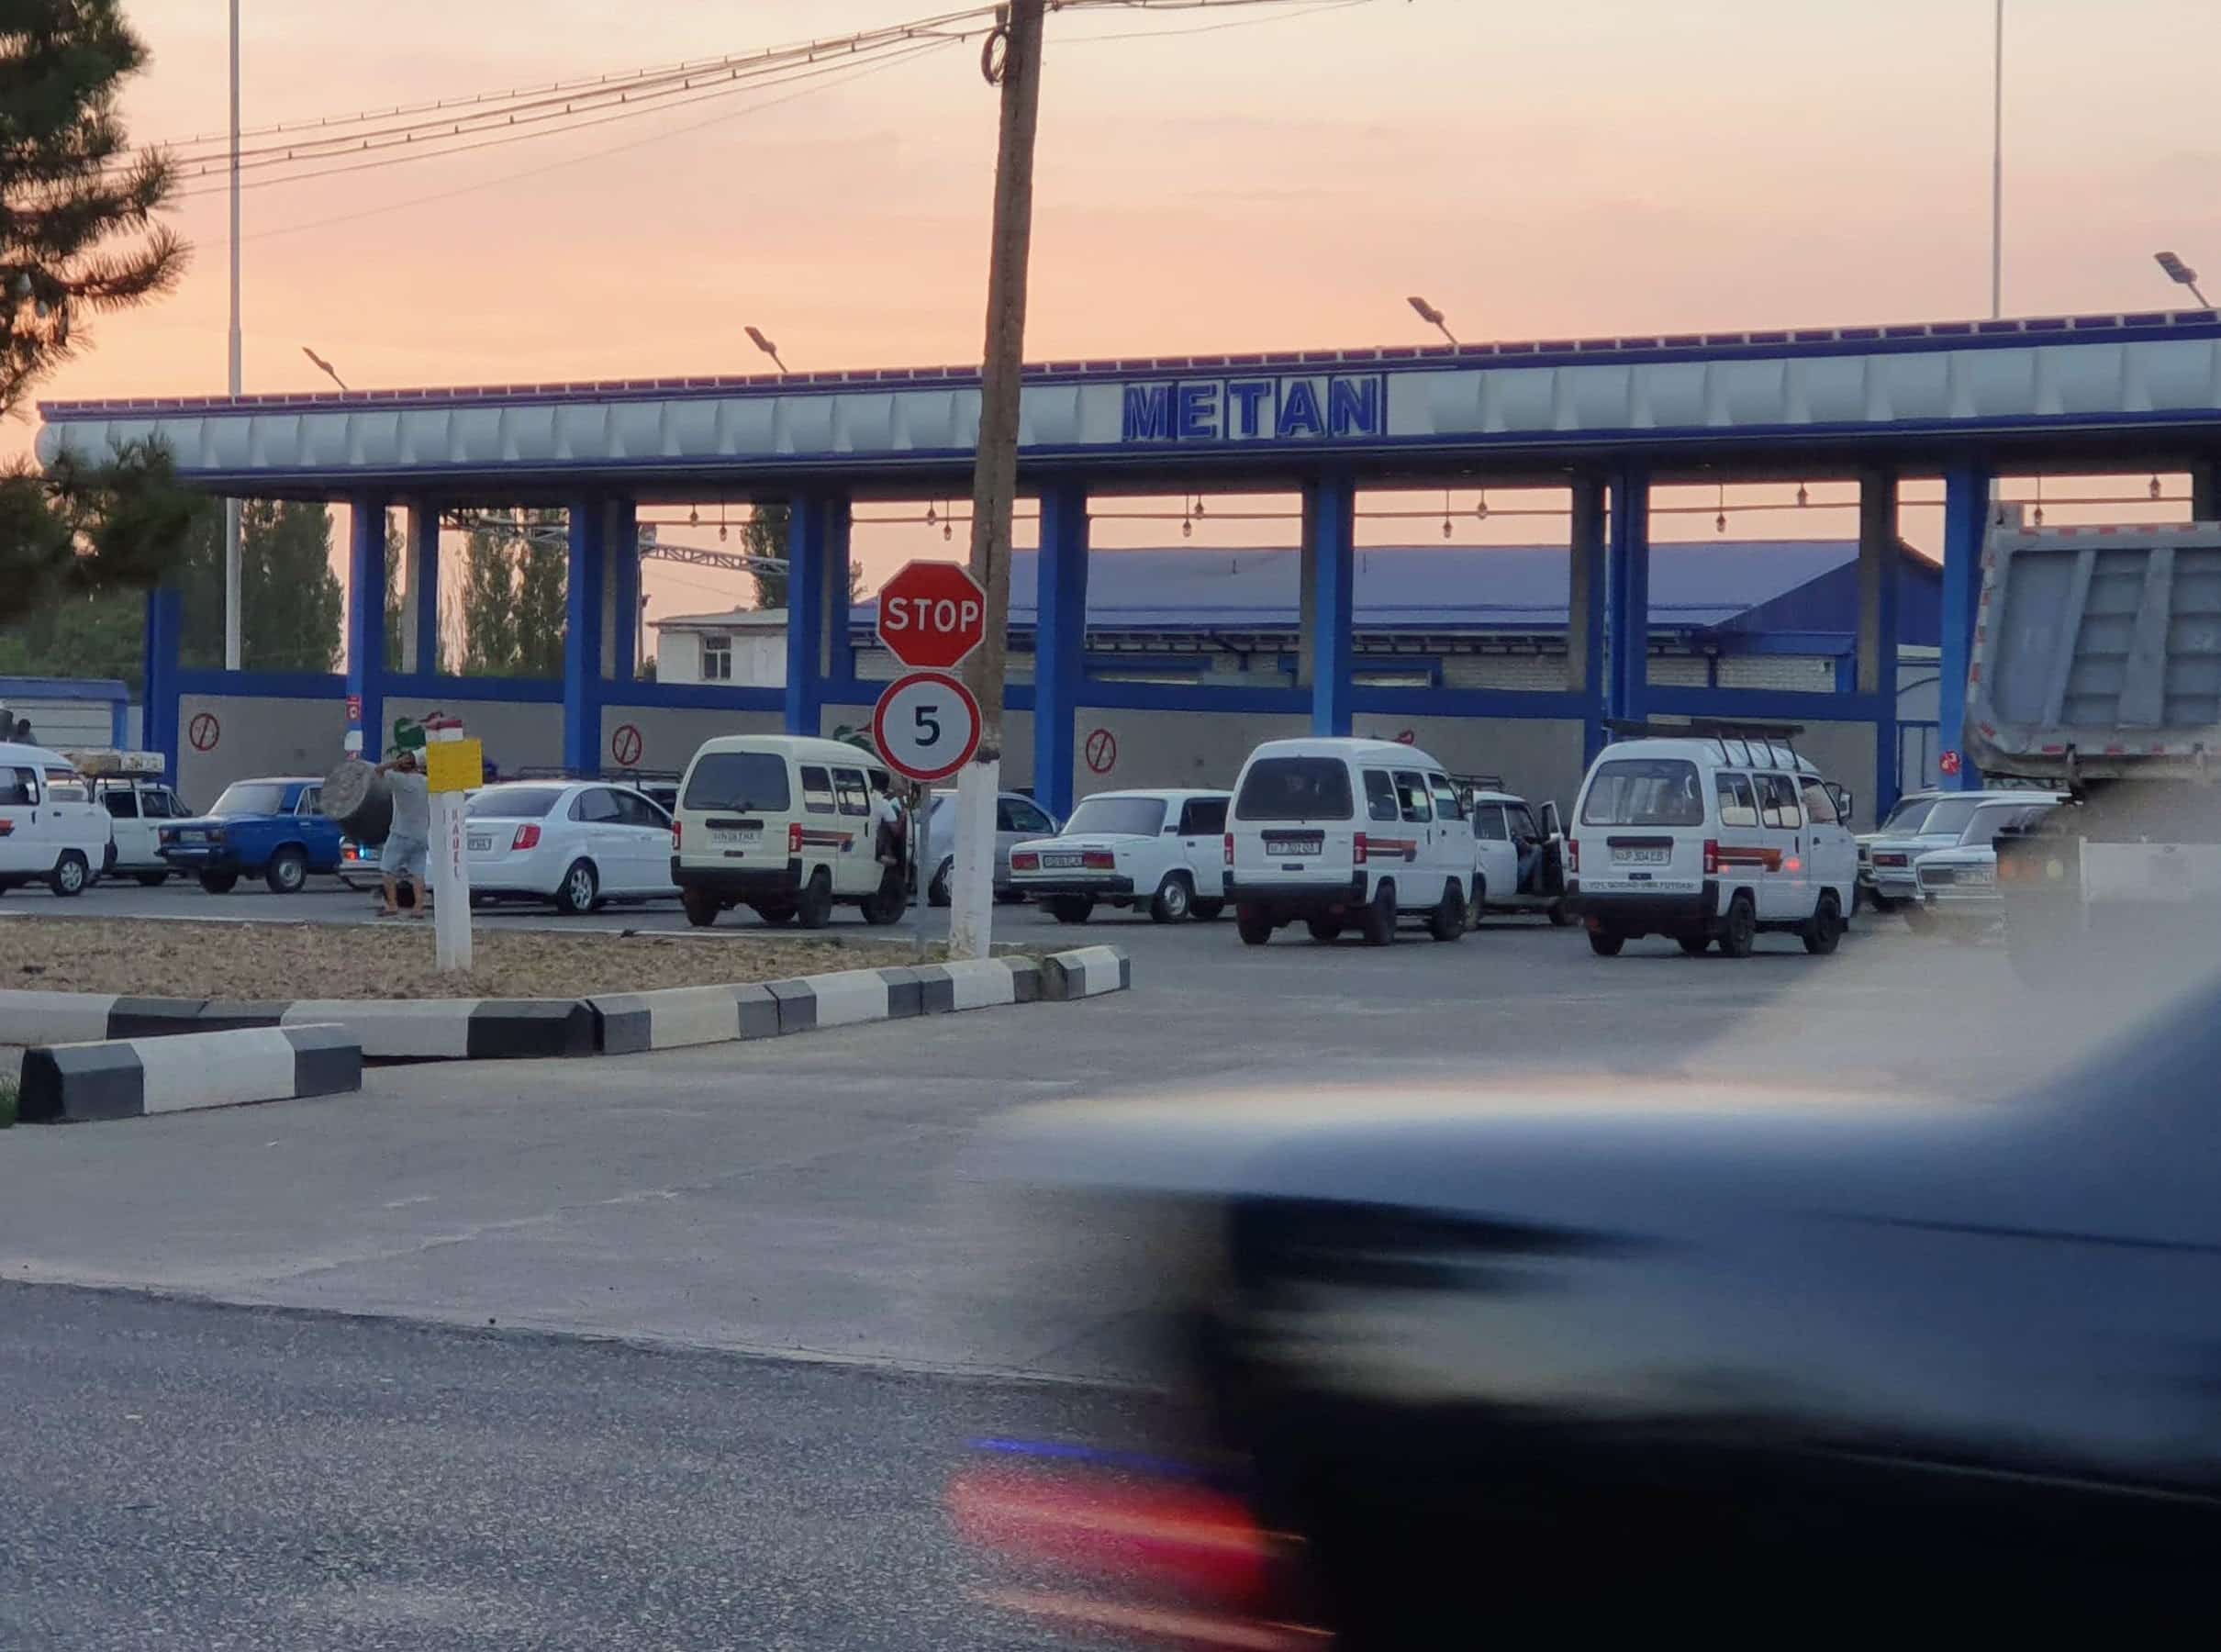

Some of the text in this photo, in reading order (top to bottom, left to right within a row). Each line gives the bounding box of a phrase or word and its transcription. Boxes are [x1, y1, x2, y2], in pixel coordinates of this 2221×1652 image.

[1122, 375, 1378, 441] METAN
[885, 597, 979, 632] STOP
[914, 705, 941, 747] 5
